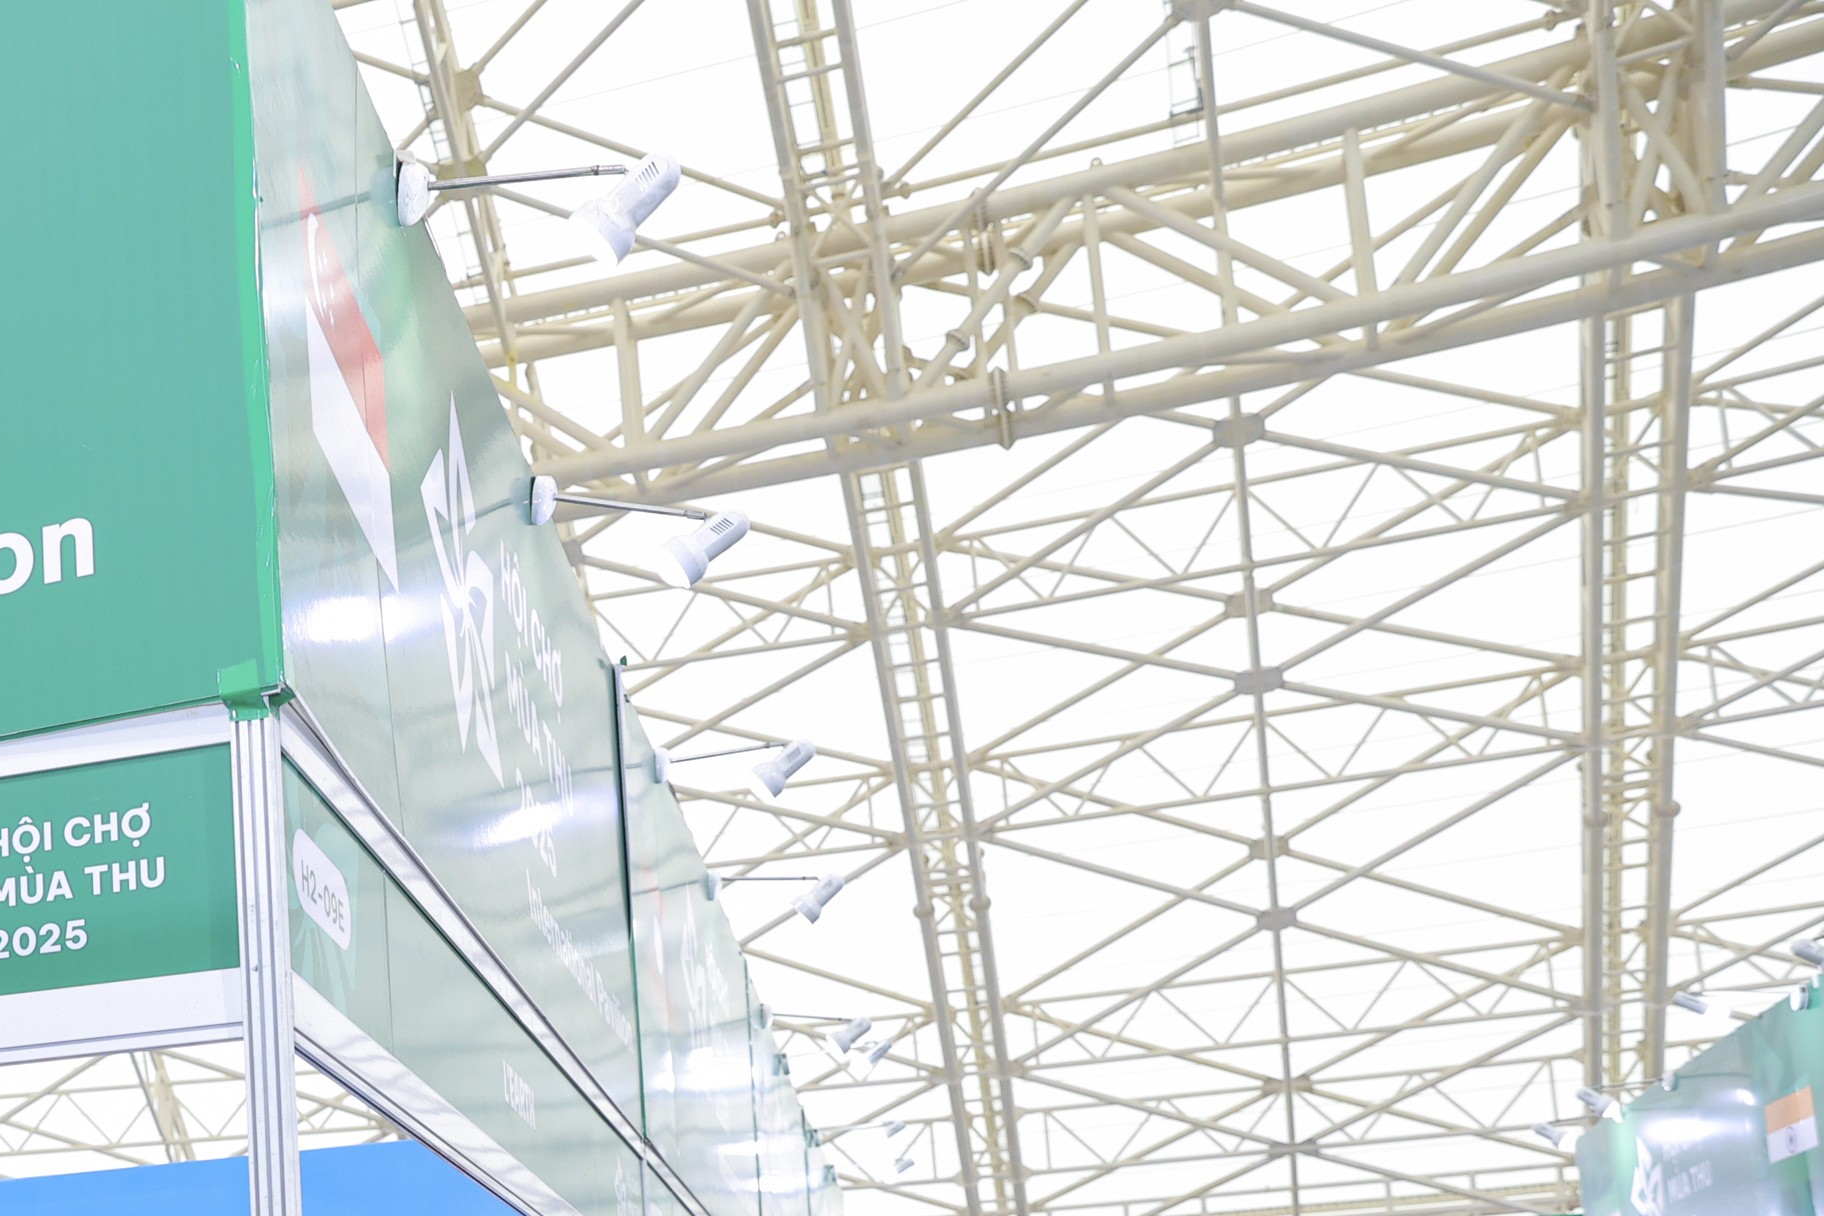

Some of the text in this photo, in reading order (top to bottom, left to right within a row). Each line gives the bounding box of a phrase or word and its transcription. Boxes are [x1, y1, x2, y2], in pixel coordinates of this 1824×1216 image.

[63, 802, 153, 849] CHỢ
[84, 856, 166, 896] THU
[300, 858, 346, 935] H2-09E
